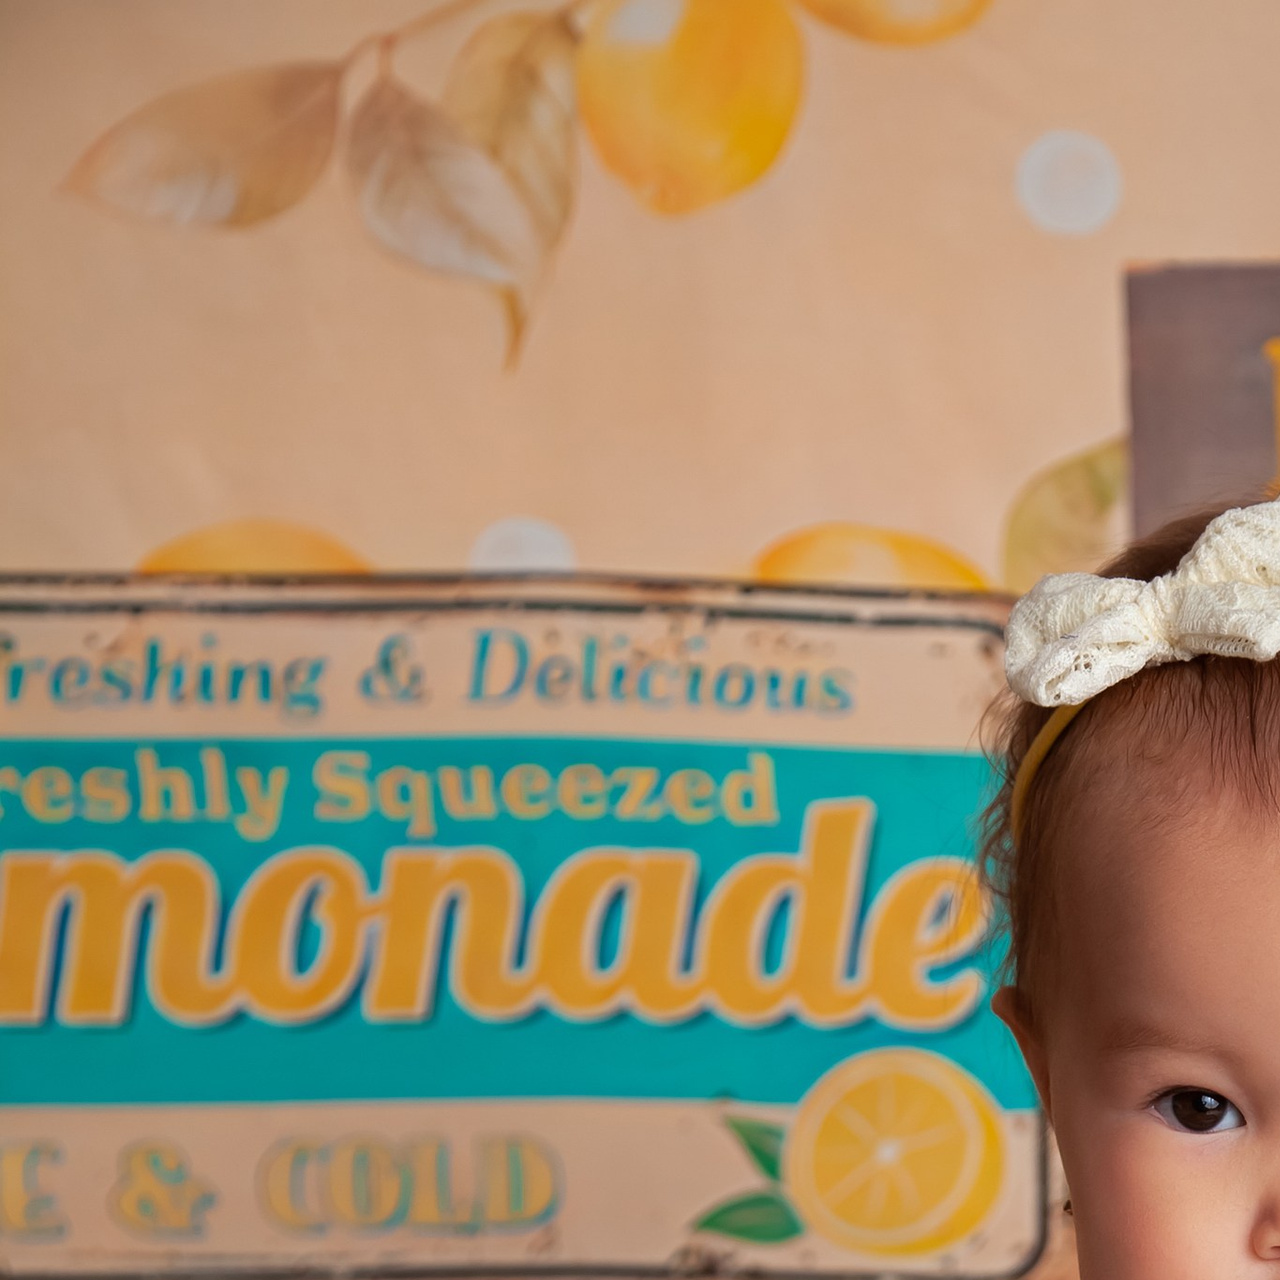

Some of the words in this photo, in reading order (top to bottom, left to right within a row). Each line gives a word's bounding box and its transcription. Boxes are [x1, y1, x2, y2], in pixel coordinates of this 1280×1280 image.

[0, 631, 328, 725] reshing
[355, 631, 431, 706] &
[467, 626, 855, 713] Delicious
[311, 749, 780, 838] Squeezed
[0, 796, 990, 1033] monade
[110, 1134, 218, 1242] &
[255, 1130, 567, 1238] COLD
